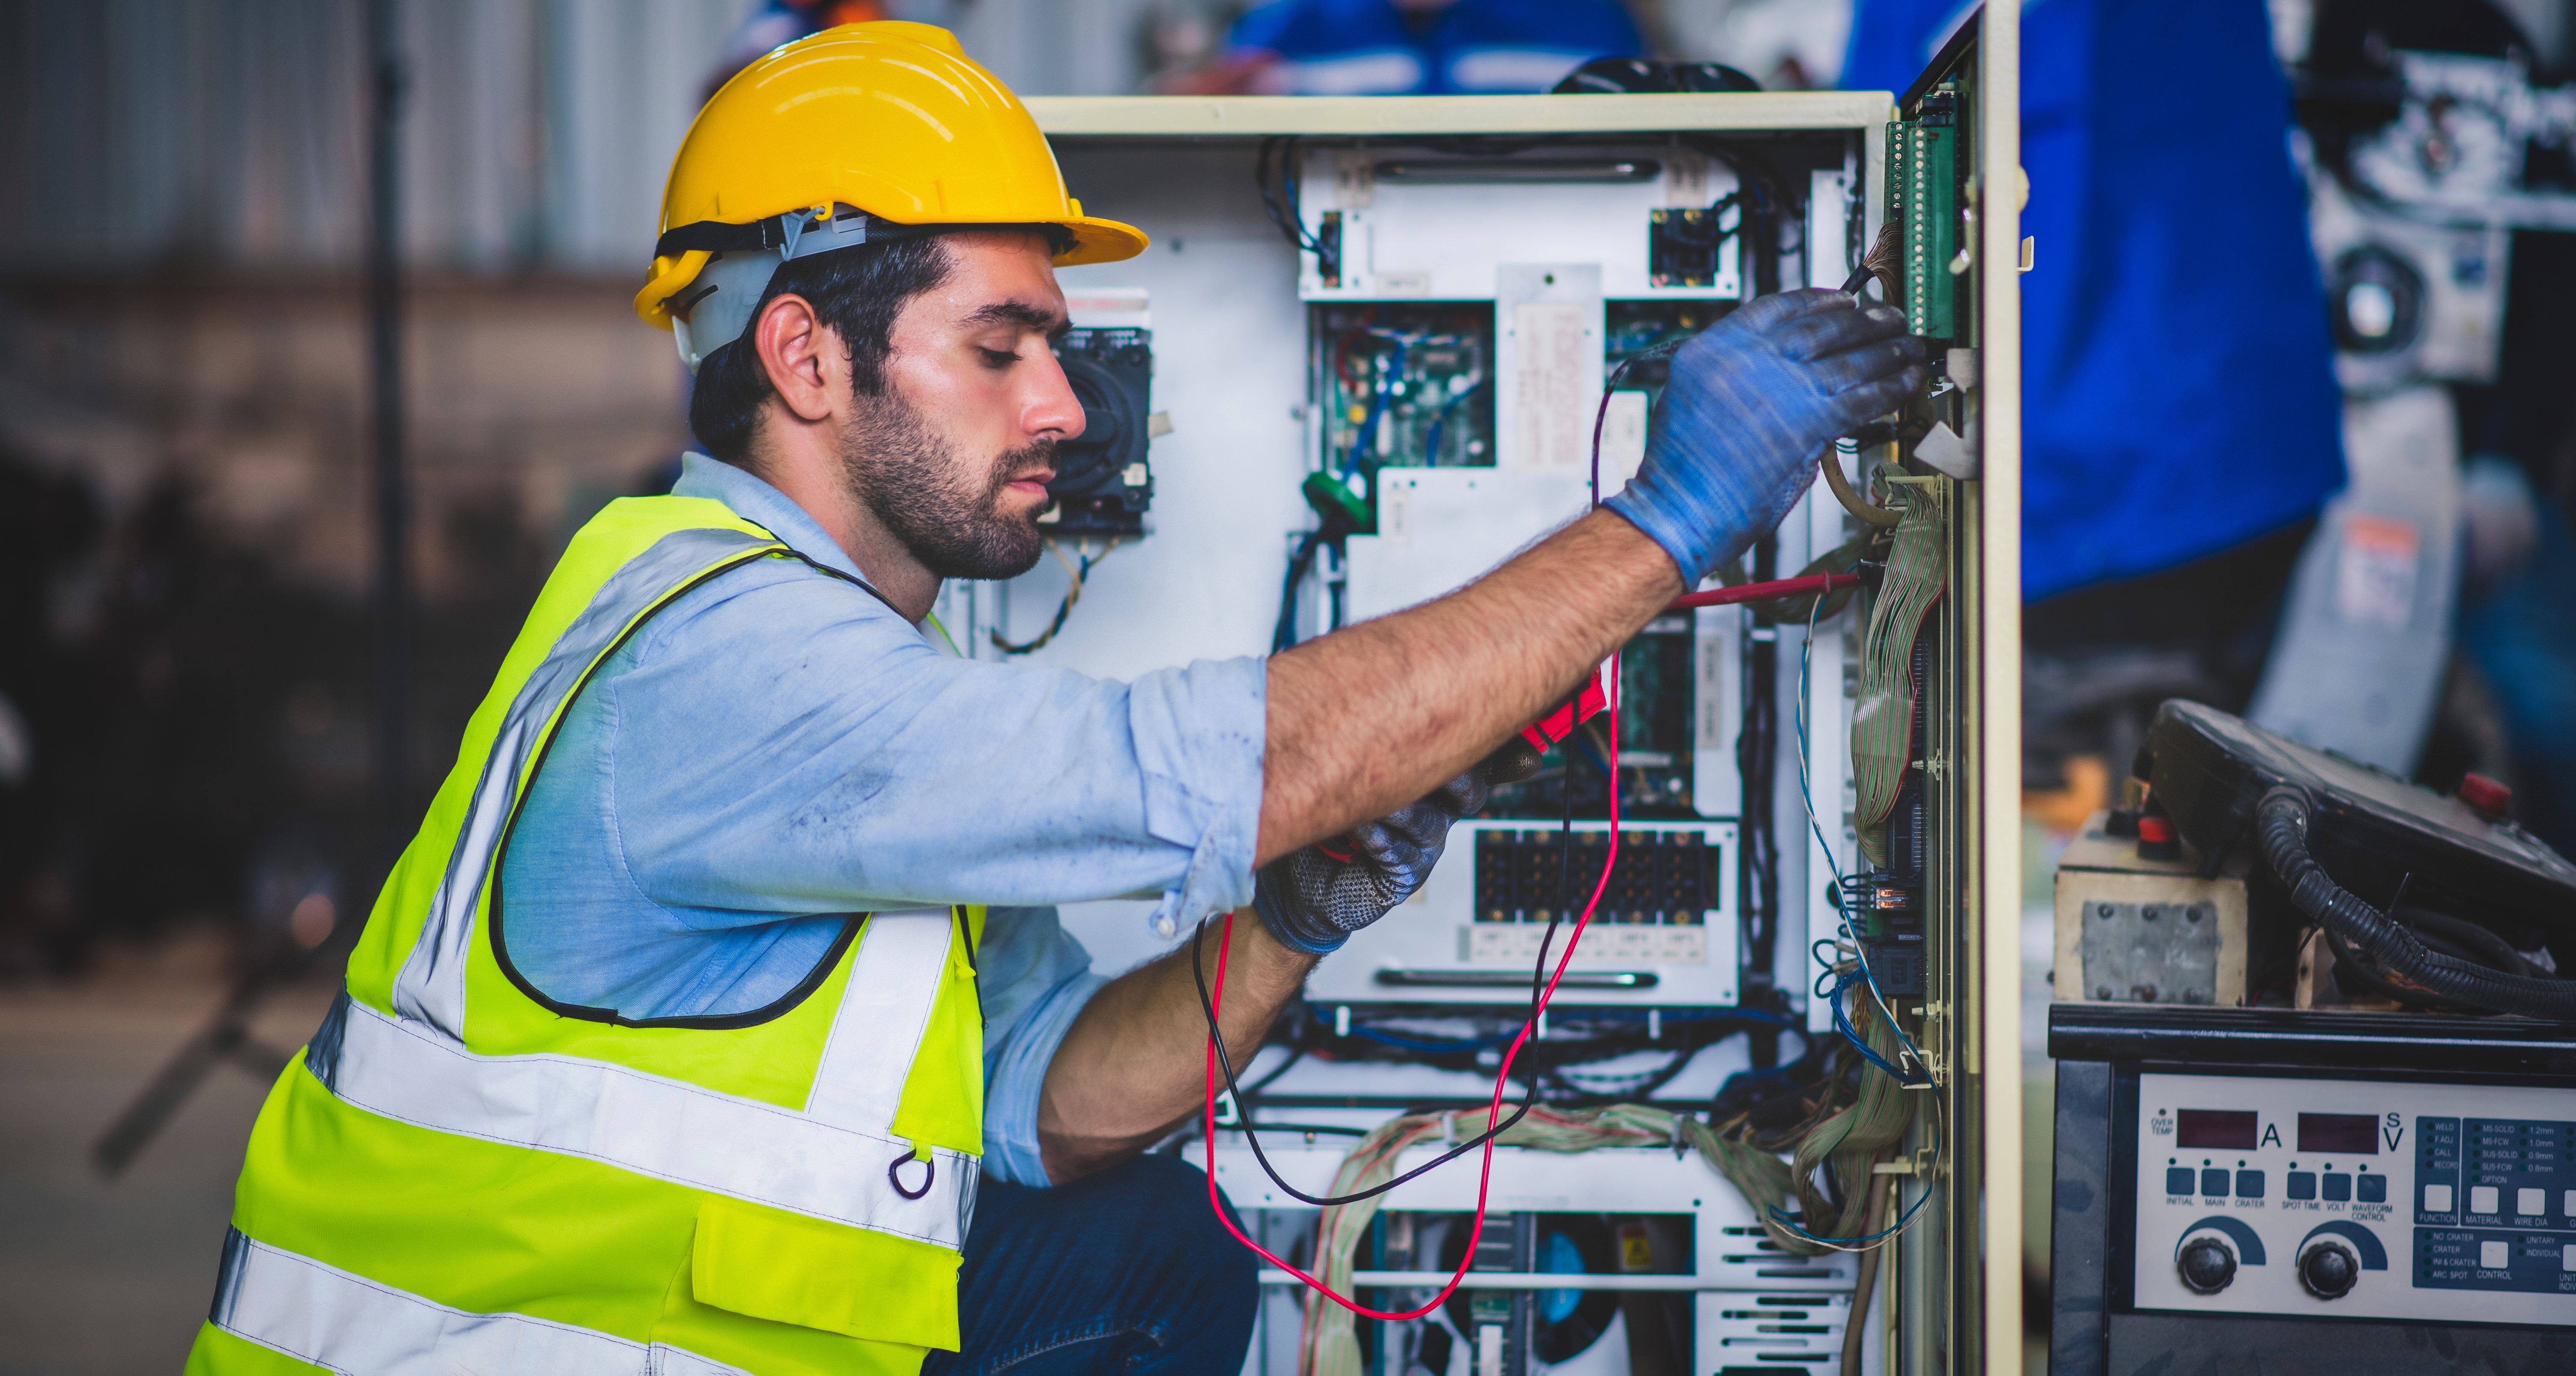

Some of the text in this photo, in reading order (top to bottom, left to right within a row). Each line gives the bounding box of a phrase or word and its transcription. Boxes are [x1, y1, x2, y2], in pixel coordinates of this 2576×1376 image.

[2151, 1118, 2173, 1126] OVER
[2387, 1112, 2400, 1128] S
[2152, 1126, 2173, 1135] TEMP
[2435, 1122, 2454, 1131] WELD
[2483, 1125, 2514, 1134] MS-SOLID
[2530, 1126, 2554, 1134] 1.2mm
[2260, 1123, 2281, 1148] A
[2383, 1127, 2404, 1152] V
[2483, 1137, 2509, 1146] MS-FCW
[2530, 1139, 2554, 1147] 1.0mm
[2435, 1148, 2452, 1157] CALL
[2482, 1149, 2517, 1159] SUS-SOLID
[2528, 1152, 2553, 1160] 0.9mm
[2434, 1161, 2459, 1170] RECORD
[2482, 1162, 2512, 1171] SUS-FCW
[2528, 1164, 2553, 1173] 0.8mm
[2482, 1175, 2507, 1183] OPTION
[2166, 1197, 2194, 1206] INITIAL
[2205, 1199, 2225, 1207] MAIN
[2235, 1200, 2265, 1208] CRATER
[2282, 1201, 2320, 1211] SPOT TIME
[2326, 1203, 2346, 1212] VOLT
[2352, 1204, 2393, 1213] WAVEFORM
[2352, 1212, 2386, 1221] CONTROL
[2420, 1213, 2457, 1223] FUNCTION
[2466, 1215, 2503, 1225] MATERIAL
[2514, 1217, 2548, 1226] WIRE DIA
[2570, 1219, 2576, 1228] G
[2433, 1232, 2474, 1242] NO CRATER
[2527, 1236, 2555, 1244] UNITARY
[2433, 1245, 2460, 1254] CRATER
[2527, 1249, 2561, 1258] INDIVIDUAL
[2433, 1257, 2442, 1266] INI
[2449, 1258, 2476, 1267] CRATER
[2433, 1270, 2468, 1279] ARC SPOT
[2477, 1269, 2512, 1280] CONTROL
